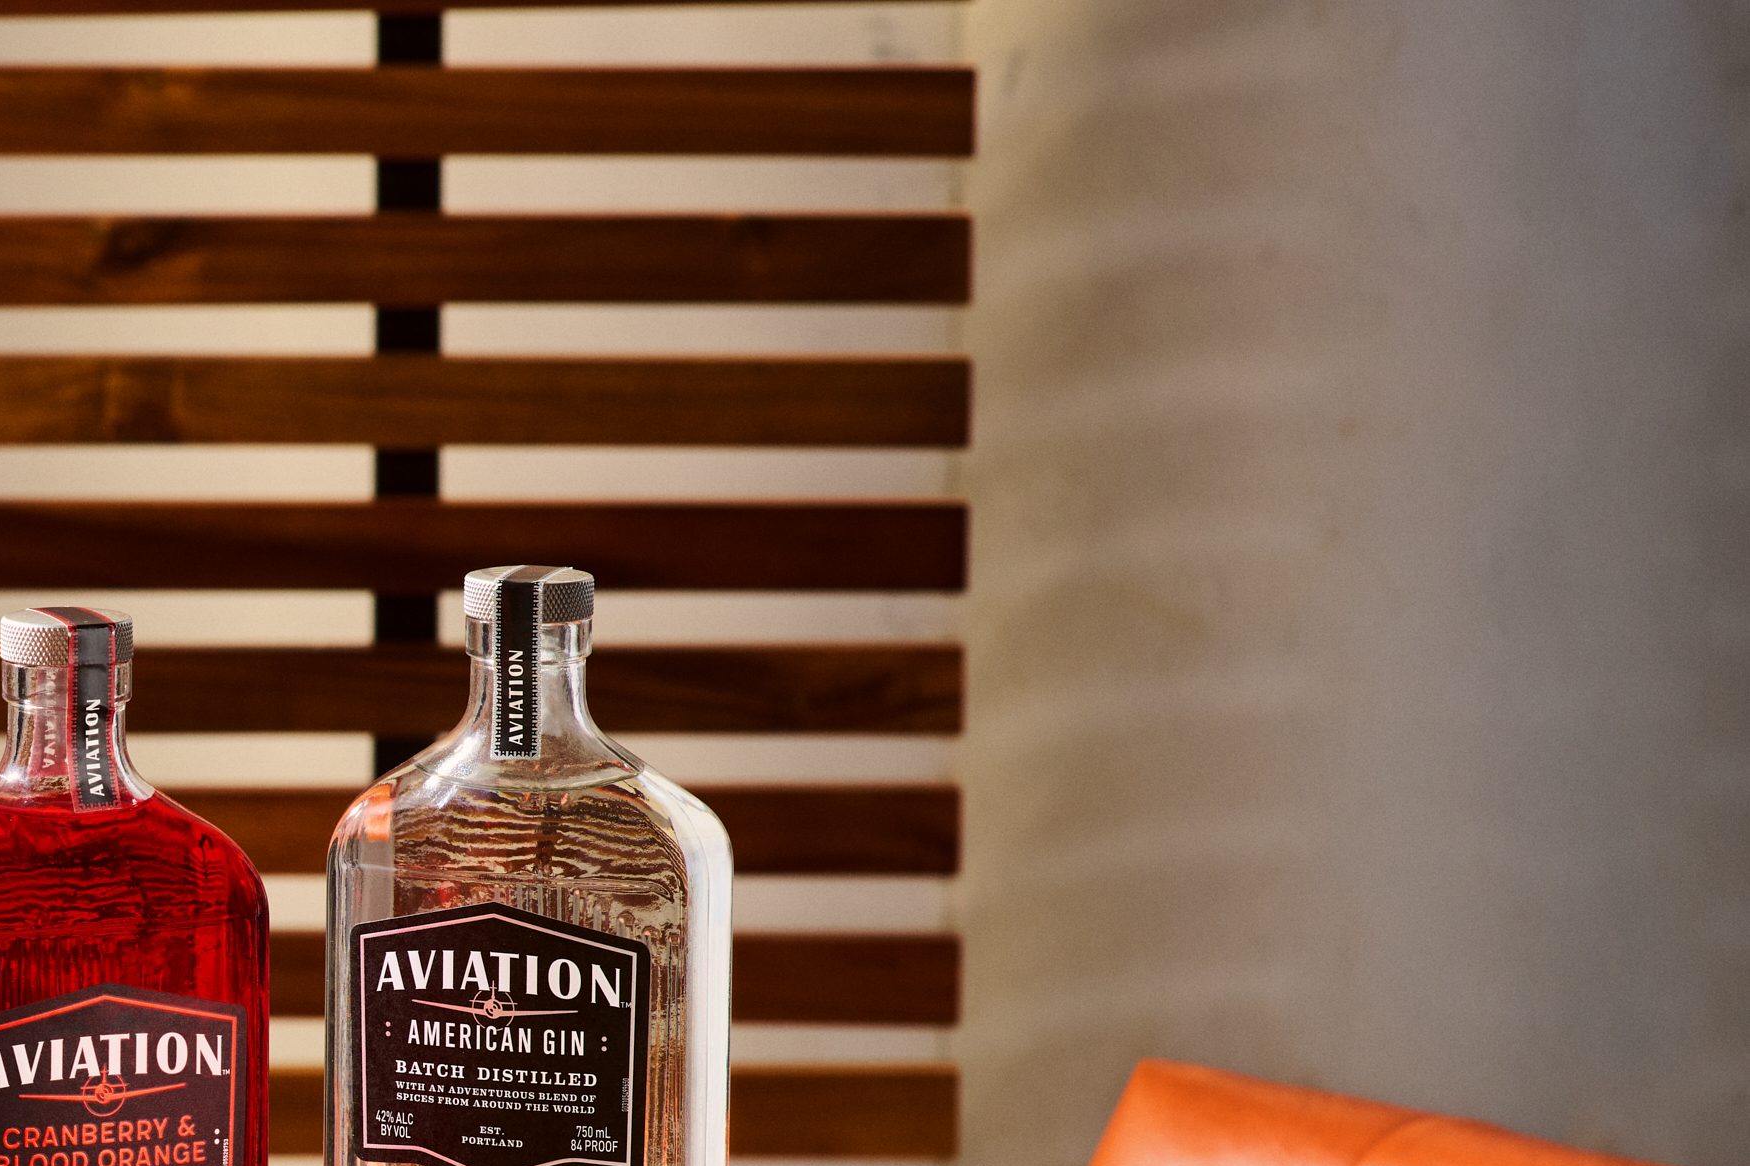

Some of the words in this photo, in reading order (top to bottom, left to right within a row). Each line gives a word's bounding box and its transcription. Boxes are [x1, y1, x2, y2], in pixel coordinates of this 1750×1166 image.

[509, 650, 523, 745] AVIATION
[85, 699, 105, 796] AVIATION
[376, 950, 621, 1008] AVIATION
[407, 1019, 532, 1053] AMERICAN
[543, 1029, 585, 1056] GIN
[395, 1060, 465, 1079] BATCH
[477, 1067, 597, 1087] DISTILLED
[395, 1080, 425, 1091] WITH
[429, 1084, 445, 1093] AN
[448, 1086, 535, 1100] ADVENTUROUS
[539, 1092, 578, 1102] BLEND
[581, 1094, 597, 1103] OF
[396, 1092, 435, 1104] SPICES
[437, 1096, 469, 1107] FROM
[472, 1099, 522, 1110] AROUND
[525, 1103, 549, 1112] THE
[553, 1104, 595, 1114] WORLD
[375, 1109, 395, 1124] 42%
[396, 1112, 414, 1125] ALC
[2, 1118, 168, 1149] CRANBERRY
[177, 1115, 196, 1137] &
[381, 1124, 393, 1137] BY
[393, 1125, 411, 1139] VOL
[479, 1126, 505, 1136] EST.
[576, 1125, 593, 1138] 750
[595, 1126, 611, 1139] mL
[461, 1136, 524, 1149] PORTLAND
[570, 1139, 583, 1151] 84
[585, 1140, 619, 1153] PROOF
